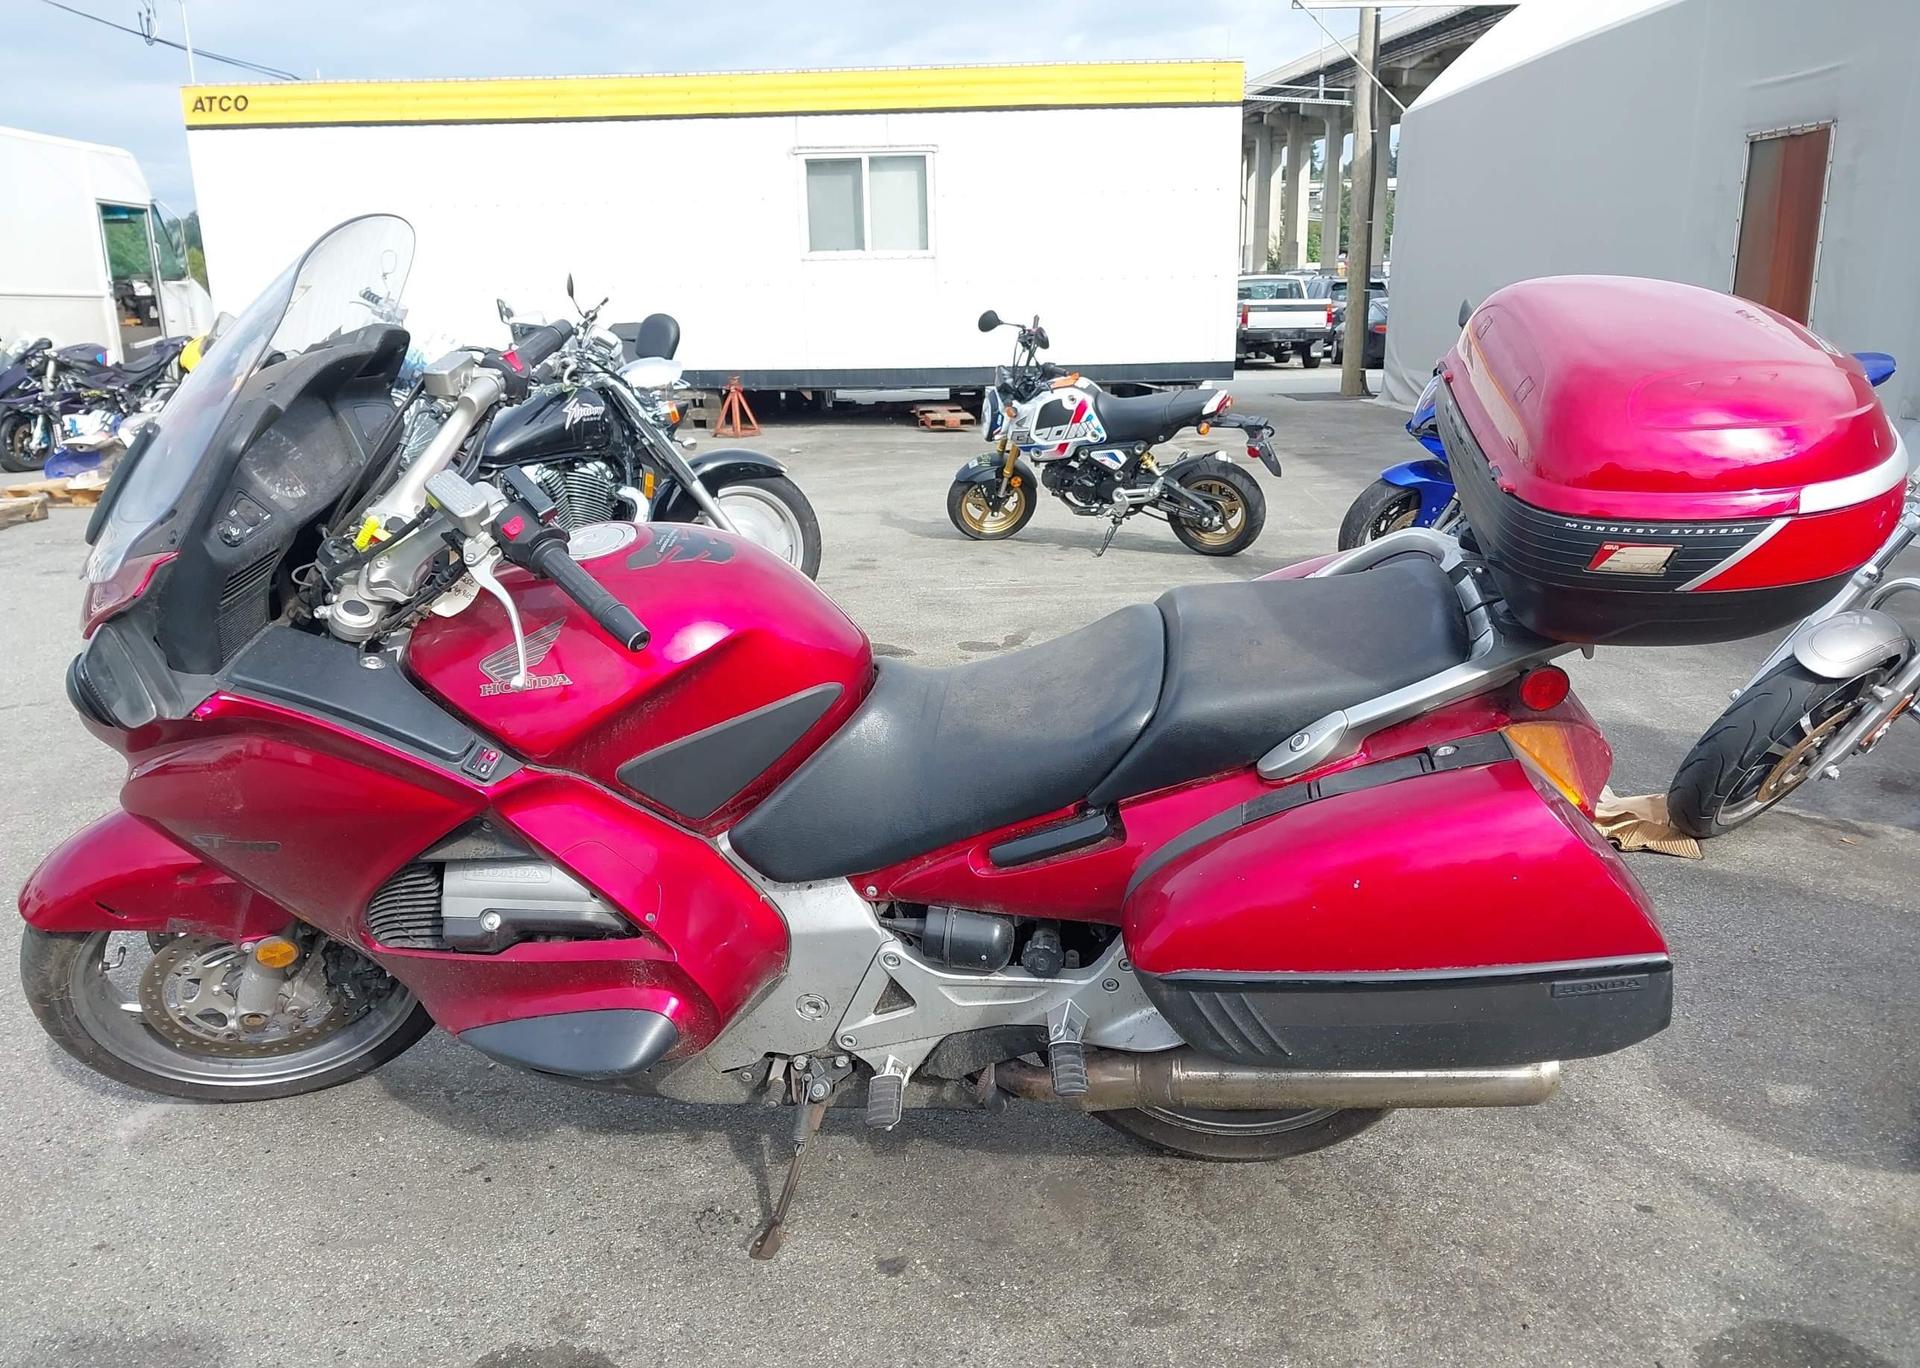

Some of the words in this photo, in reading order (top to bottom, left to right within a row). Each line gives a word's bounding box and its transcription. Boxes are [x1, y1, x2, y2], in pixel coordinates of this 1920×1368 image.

[192, 95, 249, 112] ATCO
[1565, 522, 1658, 534] MONOKEY
[1670, 527, 1745, 535] SYSTEM
